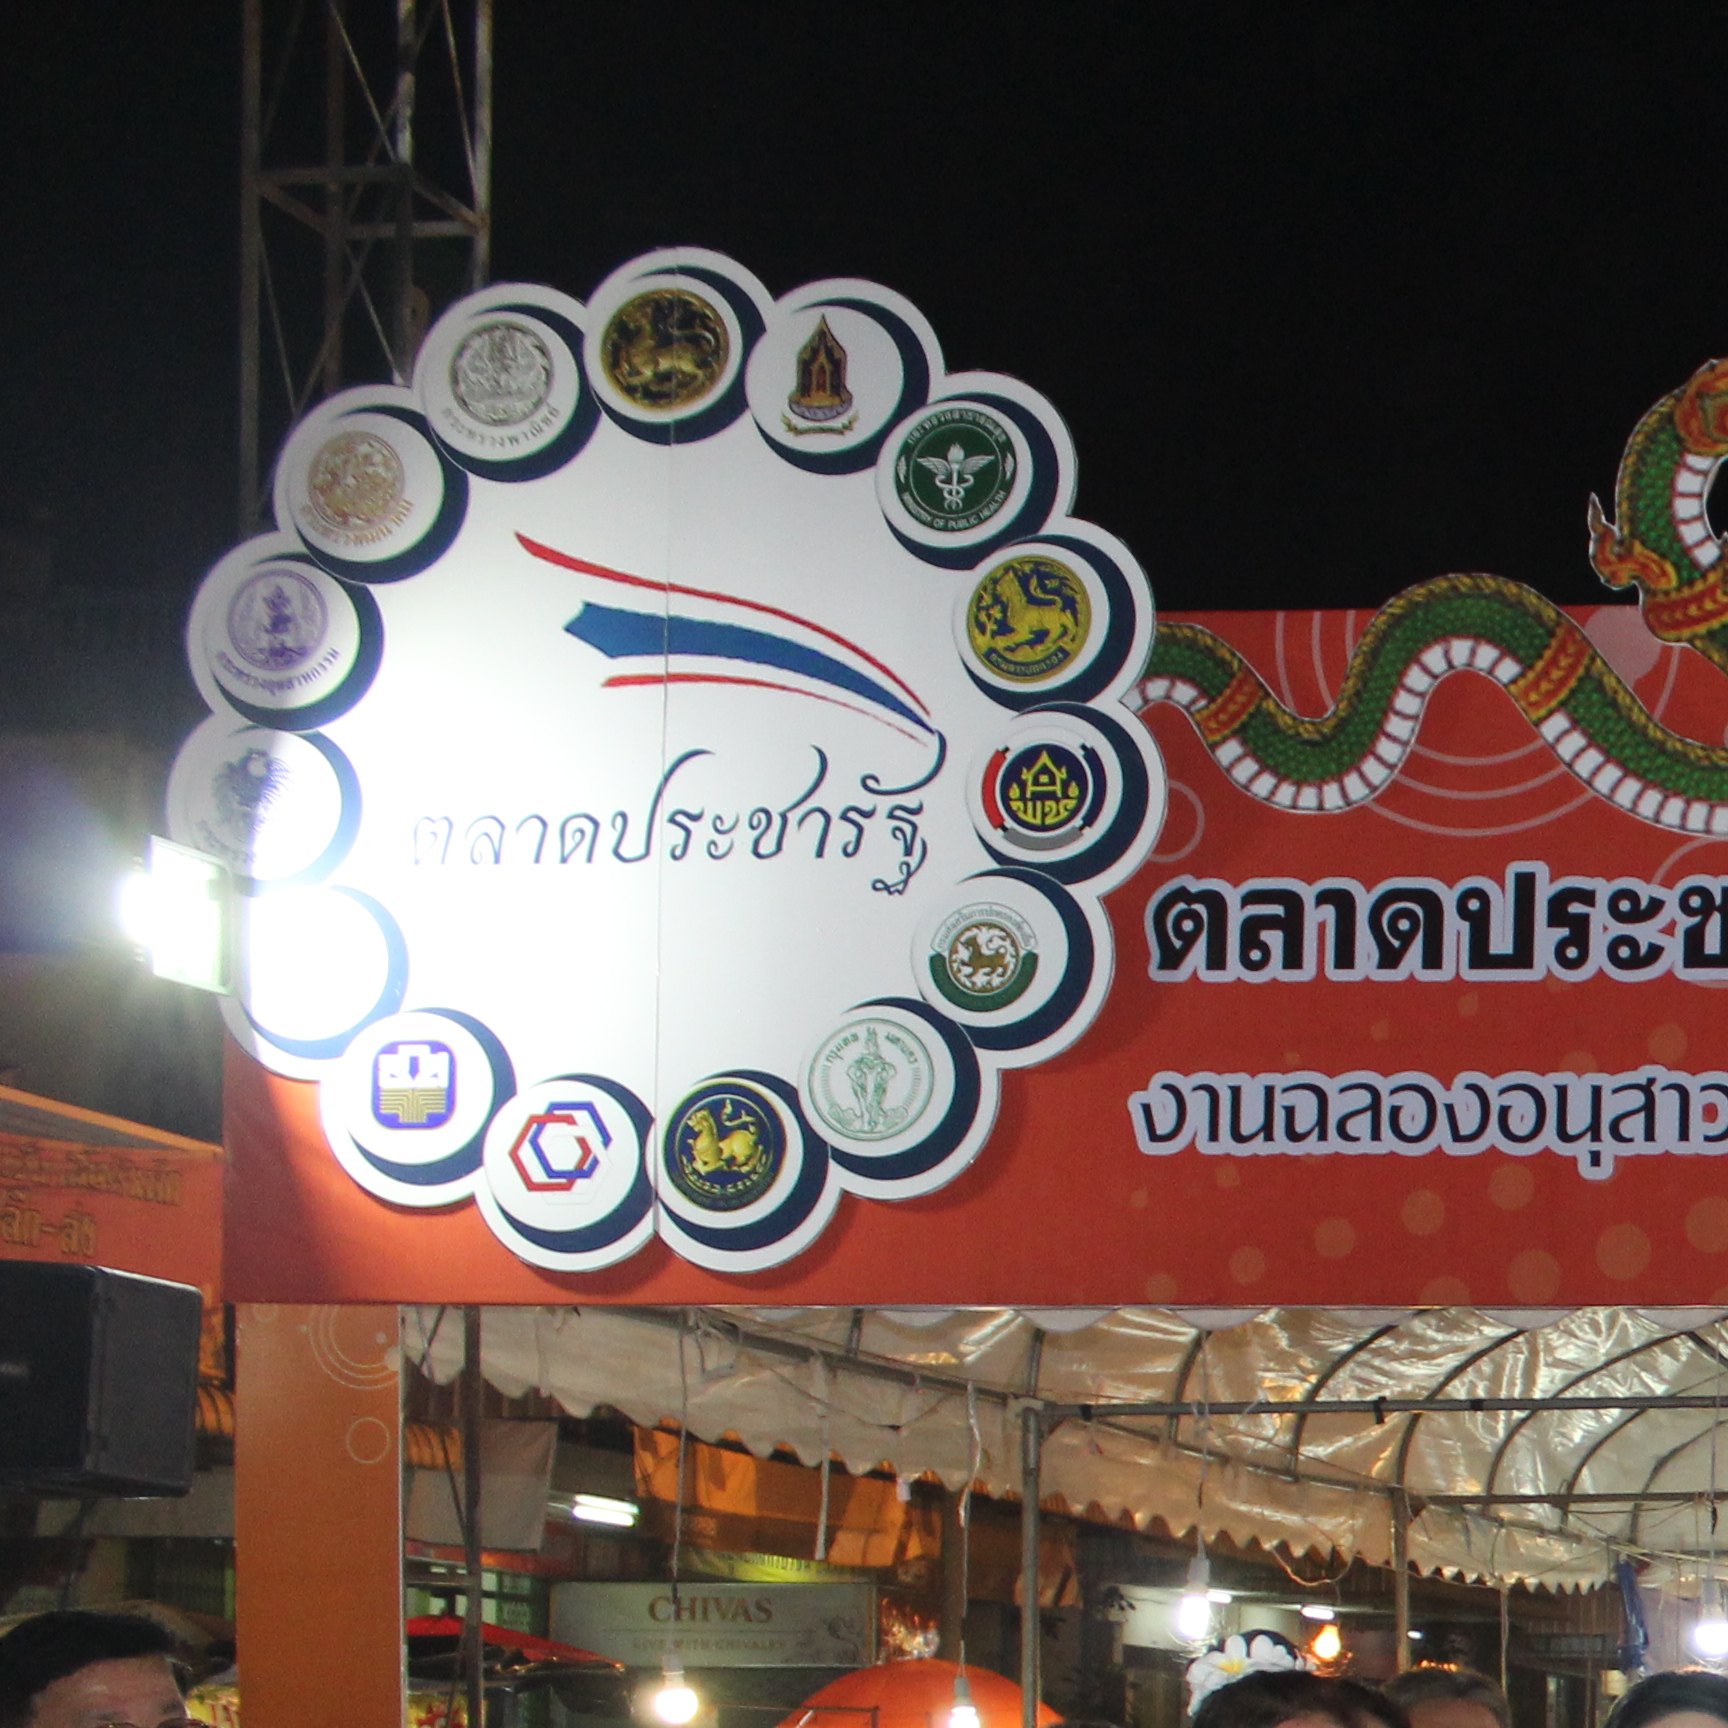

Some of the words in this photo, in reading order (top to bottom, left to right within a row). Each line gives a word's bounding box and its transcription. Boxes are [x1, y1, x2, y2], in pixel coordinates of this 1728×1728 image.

[413, 729, 947, 897] ตลาดประชารัฐ
[648, 1596, 774, 1623] CHIVAS
